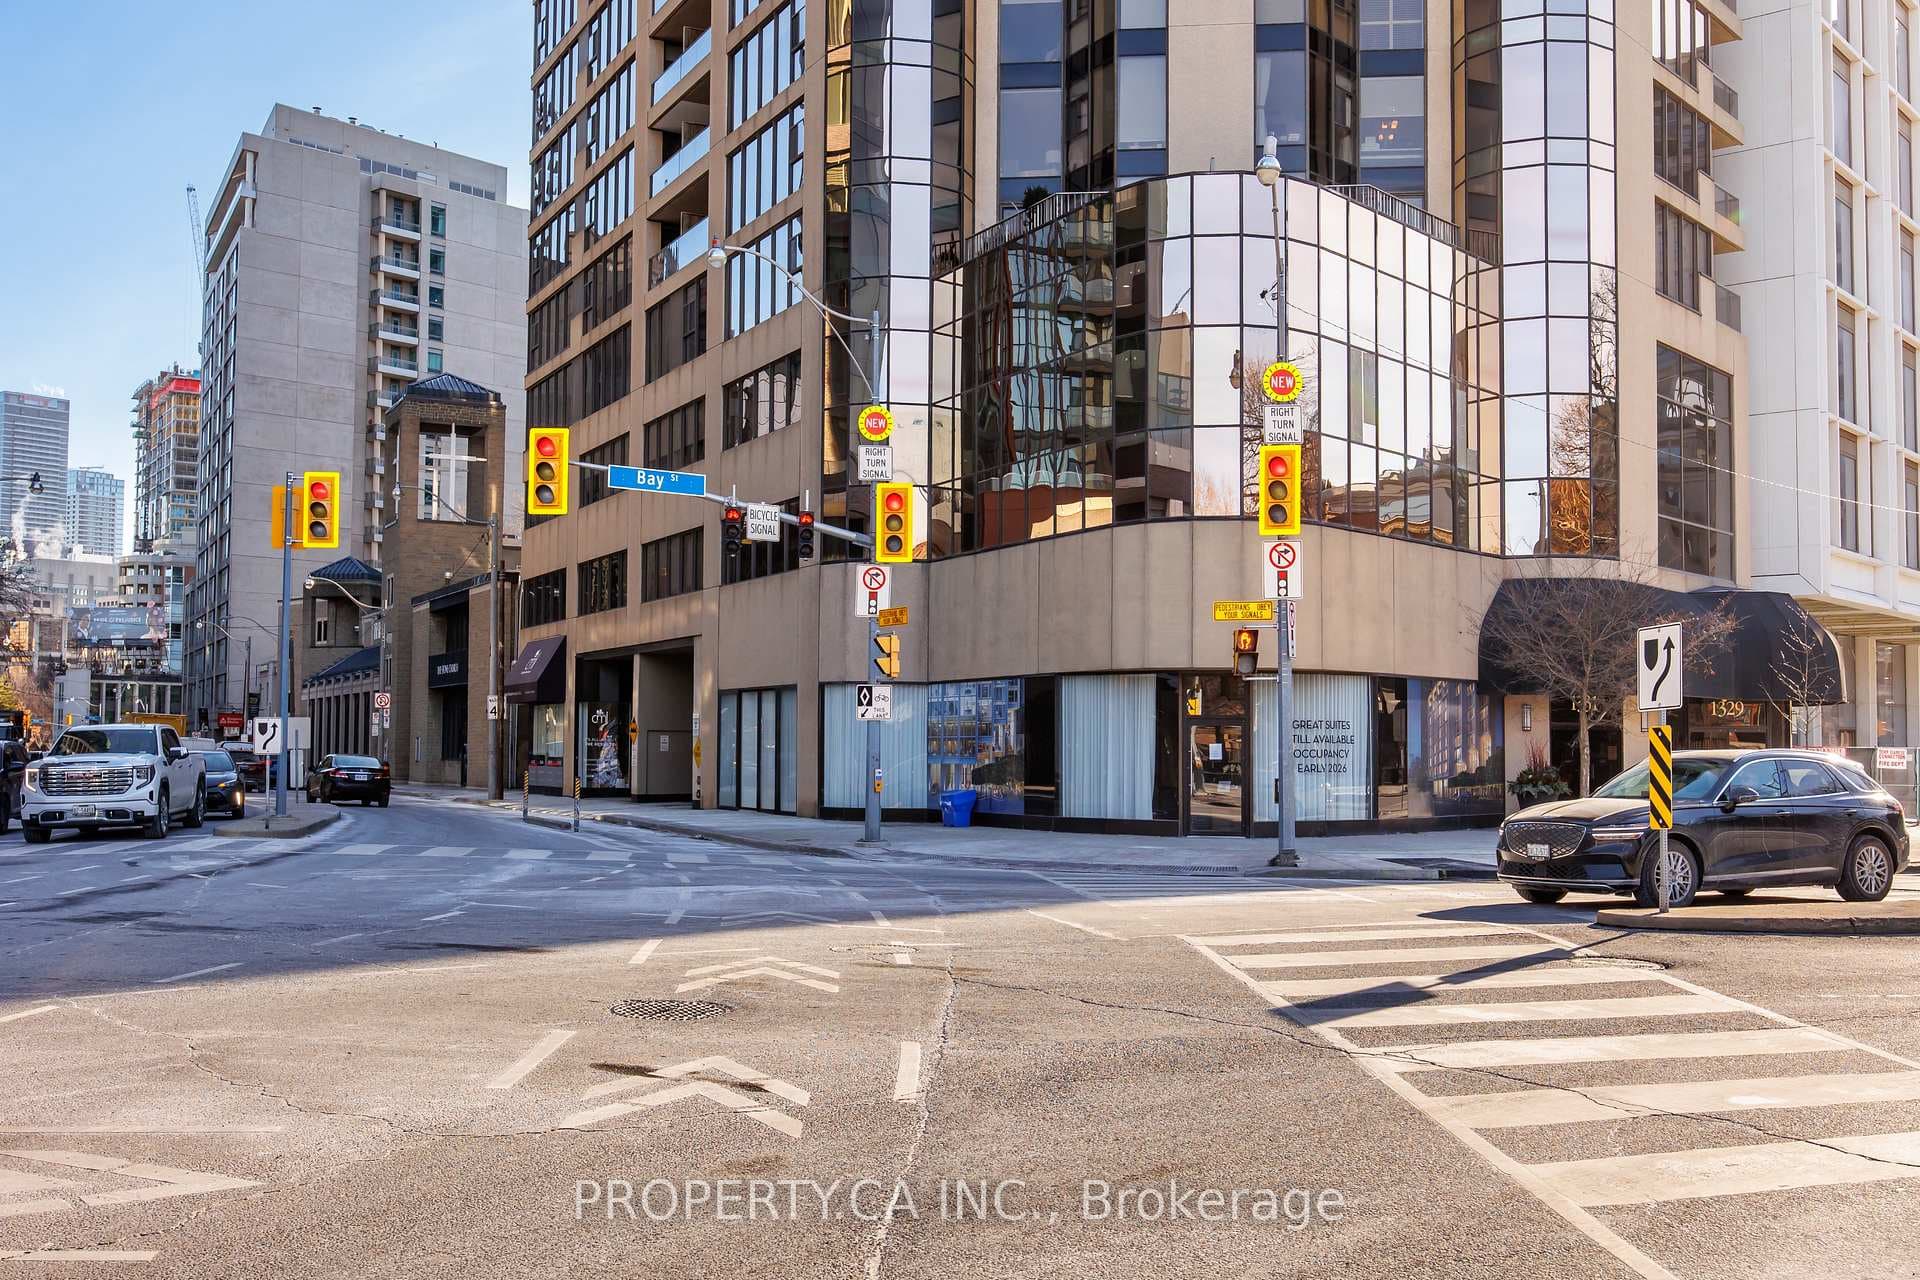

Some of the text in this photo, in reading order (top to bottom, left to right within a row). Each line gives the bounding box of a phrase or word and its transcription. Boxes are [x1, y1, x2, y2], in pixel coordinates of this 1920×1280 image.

[1271, 376, 1294, 388] NEW
[1271, 408, 1294, 416] RIGHT
[866, 418, 886, 429] NEW
[1272, 420, 1294, 429] TURN
[1268, 433, 1298, 441] SIGNAL
[865, 448, 886, 456] RIGHT
[866, 459, 886, 467] TURN
[862, 470, 889, 478] SIGNAL
[637, 470, 679, 490] Bay St
[750, 509, 778, 522] BICYCLE
[750, 523, 777, 536] SIGNAL
[1215, 603, 1271, 612] PEDESTRIANS OBEY
[1224, 611, 1264, 619] YOUR SIGNALS
[1711, 699, 1744, 718] 1329
[1292, 720, 1351, 730] GREAT SUITES
[1292, 735, 1355, 745] TILL AVAILABLE
[1293, 749, 1350, 758] OCCUPANCY
[1297, 764, 1347, 773] EARLY 2026
